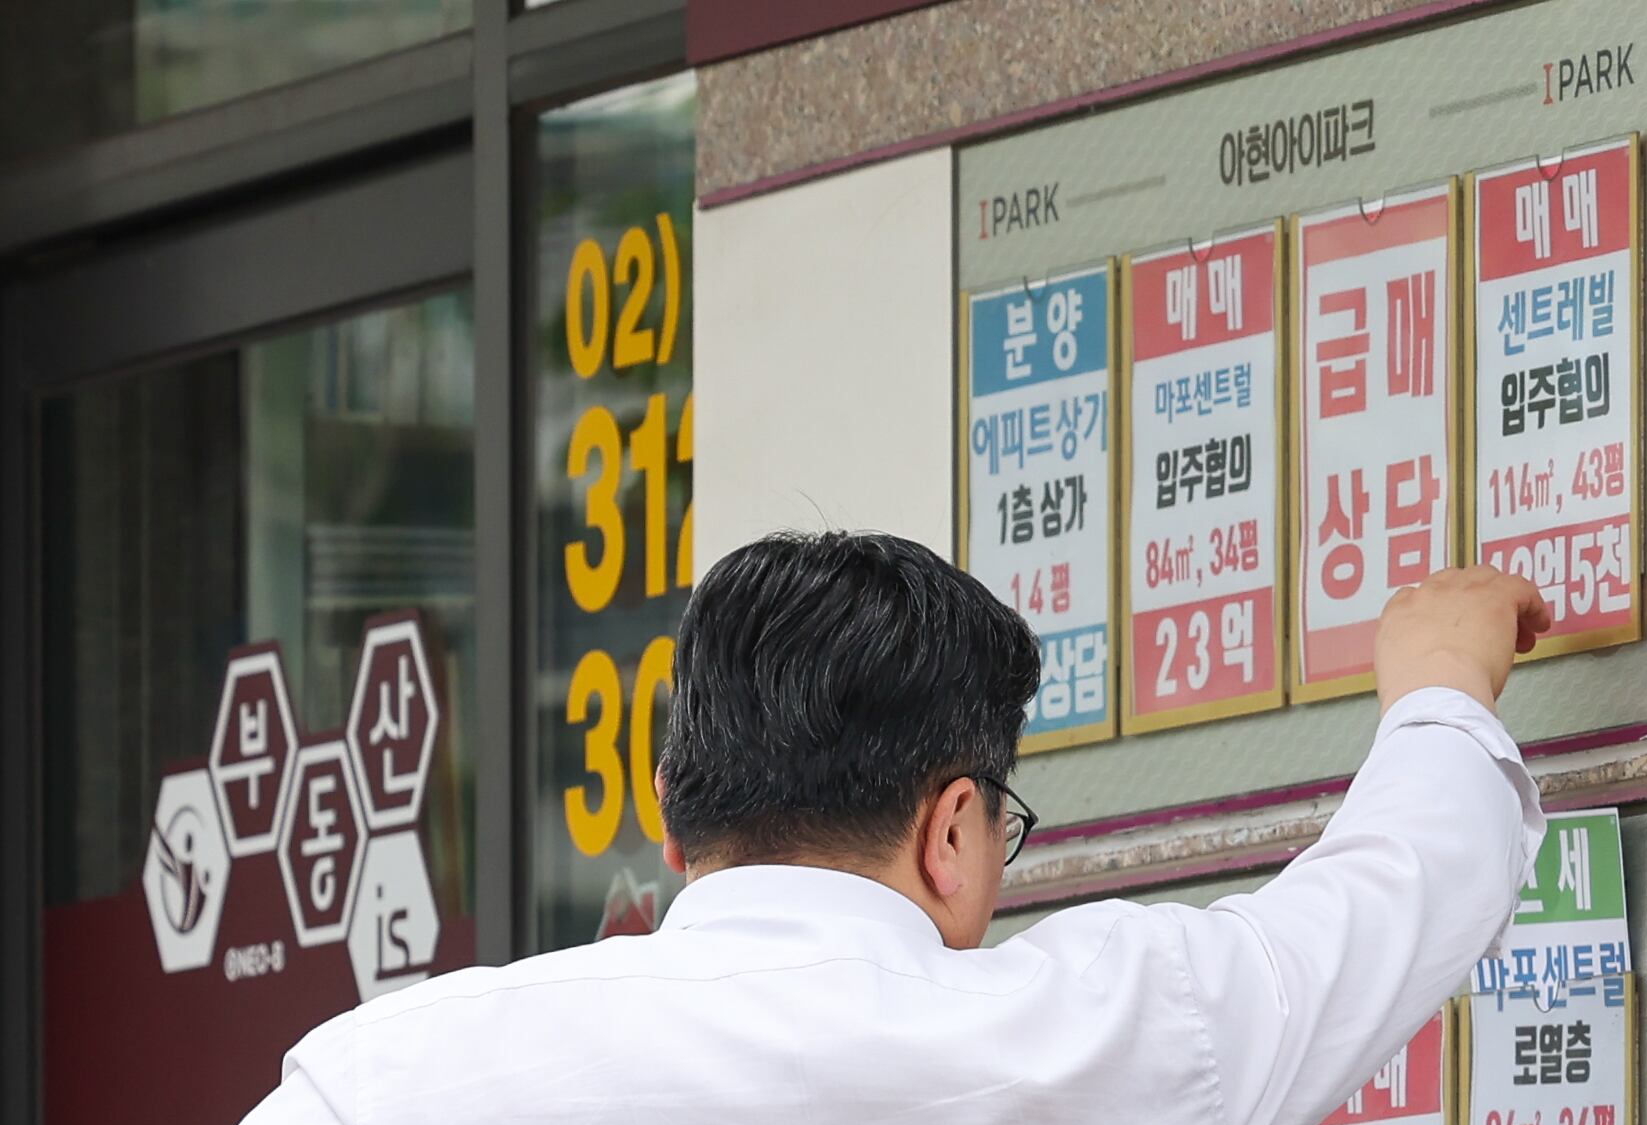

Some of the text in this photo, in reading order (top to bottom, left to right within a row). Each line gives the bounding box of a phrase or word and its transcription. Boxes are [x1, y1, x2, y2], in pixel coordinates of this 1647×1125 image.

[1220, 99, 1375, 186] 아현아이파크
[567, 214, 680, 379] 02)
[1498, 270, 1615, 357] 센트레빌
[1155, 363, 1251, 423] 마포센트럴
[1501, 346, 1609, 436] 입주협의
[1157, 434, 1251, 509] 입주협의
[1571, 441, 1624, 501] 43평
[998, 475, 1087, 545] 1층 상가
[1210, 520, 1258, 575] 34평
[1489, 523, 1630, 622] 억5천
[1025, 631, 1107, 721] 상담
[1477, 942, 1624, 1013] 마포센트럴
[1514, 1020, 1591, 1085] 로열층
